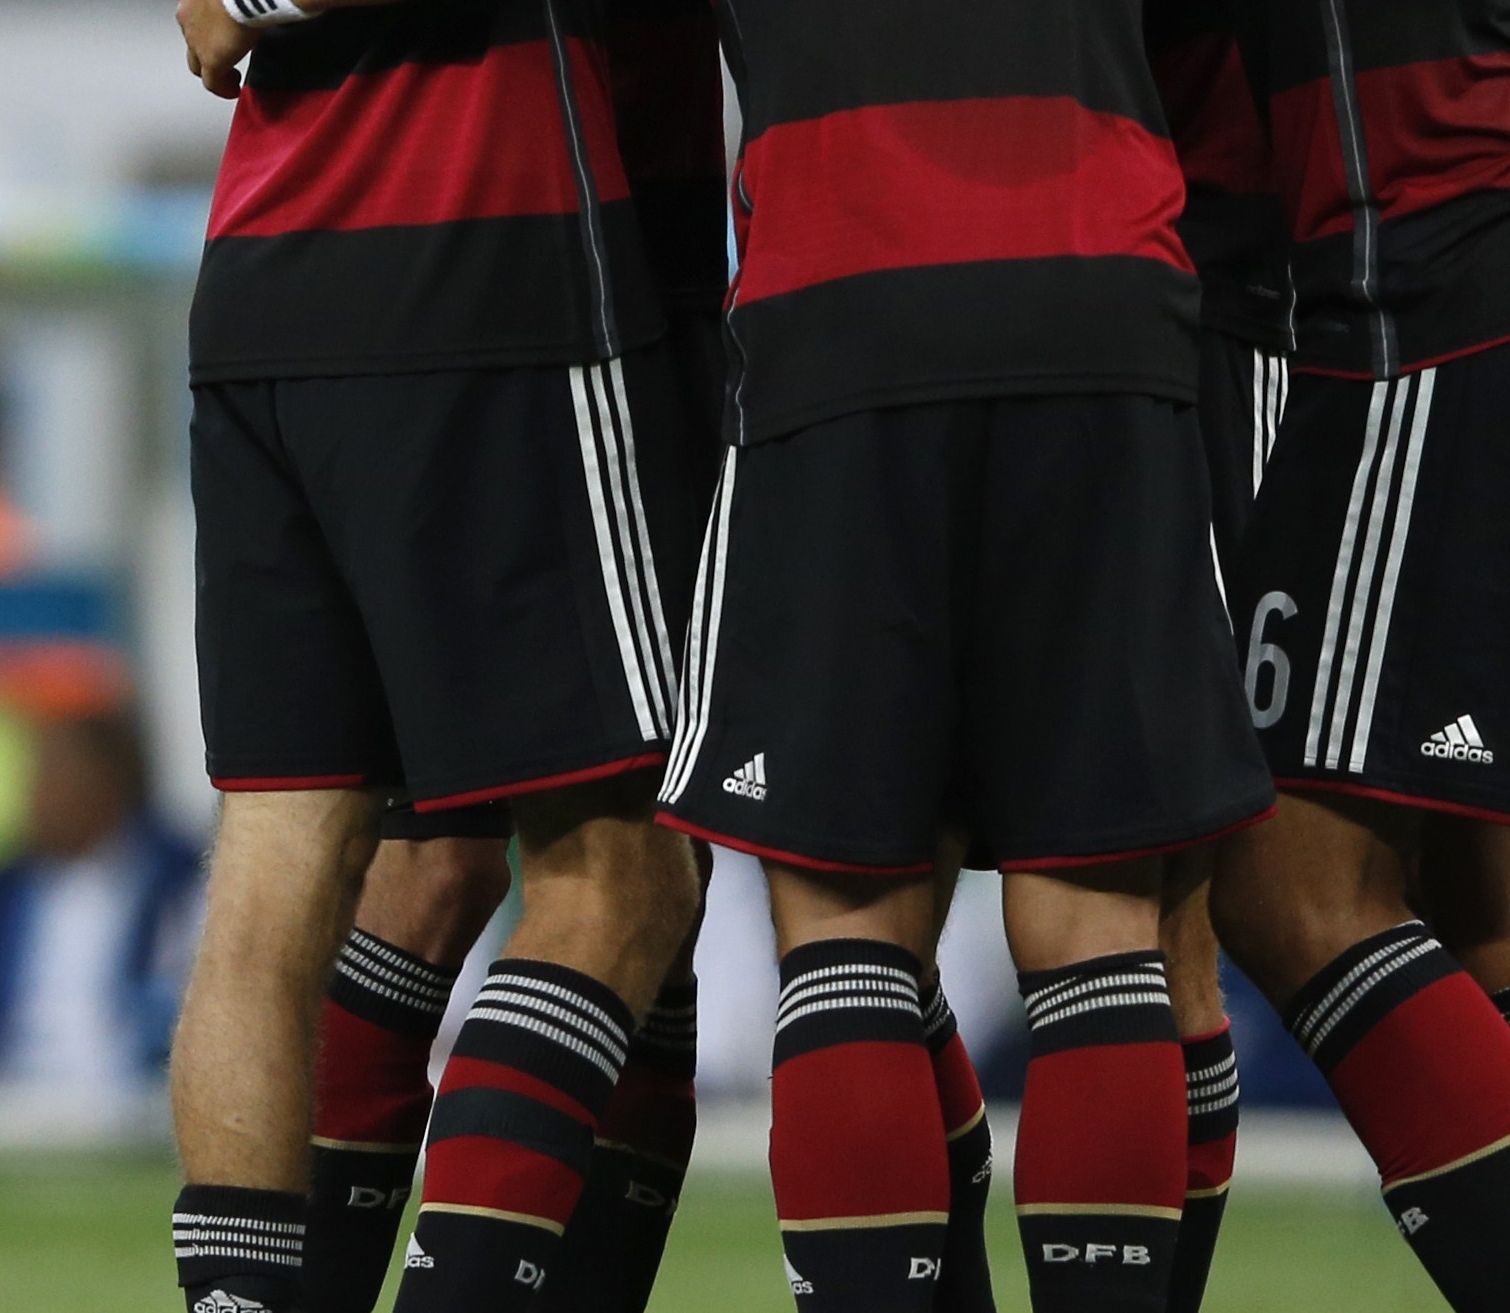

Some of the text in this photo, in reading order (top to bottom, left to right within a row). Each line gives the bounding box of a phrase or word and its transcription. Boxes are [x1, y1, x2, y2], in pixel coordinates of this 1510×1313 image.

[1244, 590, 1299, 728] 6
[1421, 740, 1494, 764] adidas
[1042, 1243, 1151, 1265] DFB
